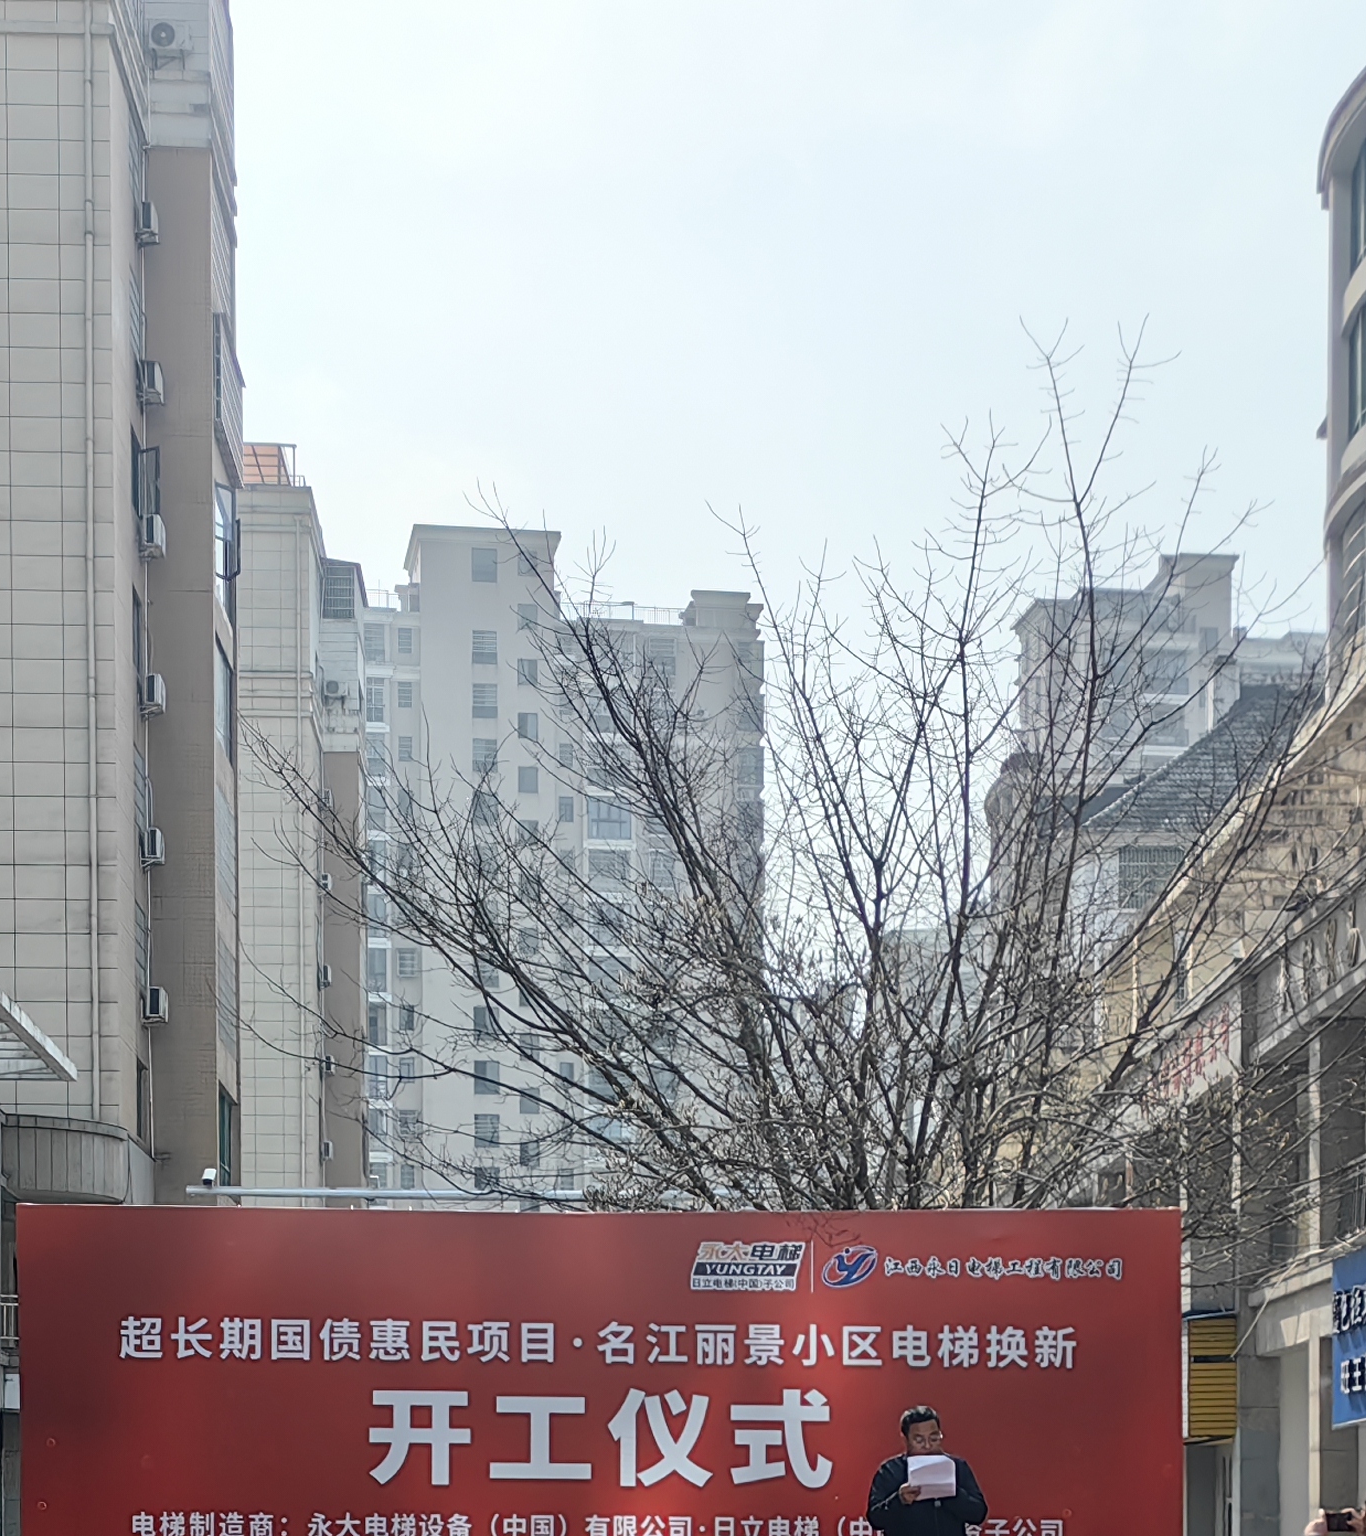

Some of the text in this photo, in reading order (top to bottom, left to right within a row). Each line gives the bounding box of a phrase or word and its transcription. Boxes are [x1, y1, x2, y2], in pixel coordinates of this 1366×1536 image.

[698, 1241, 804, 1261] 永大电梯
[705, 1264, 787, 1275] YUNGTAY
[883, 1256, 1123, 1281] 江西永日电梯工程有限公司
[119, 1316, 1078, 1370] 超长期国债惠民项目·名江丽景小区电梯换新
[368, 1387, 834, 1489] 开工仪式
